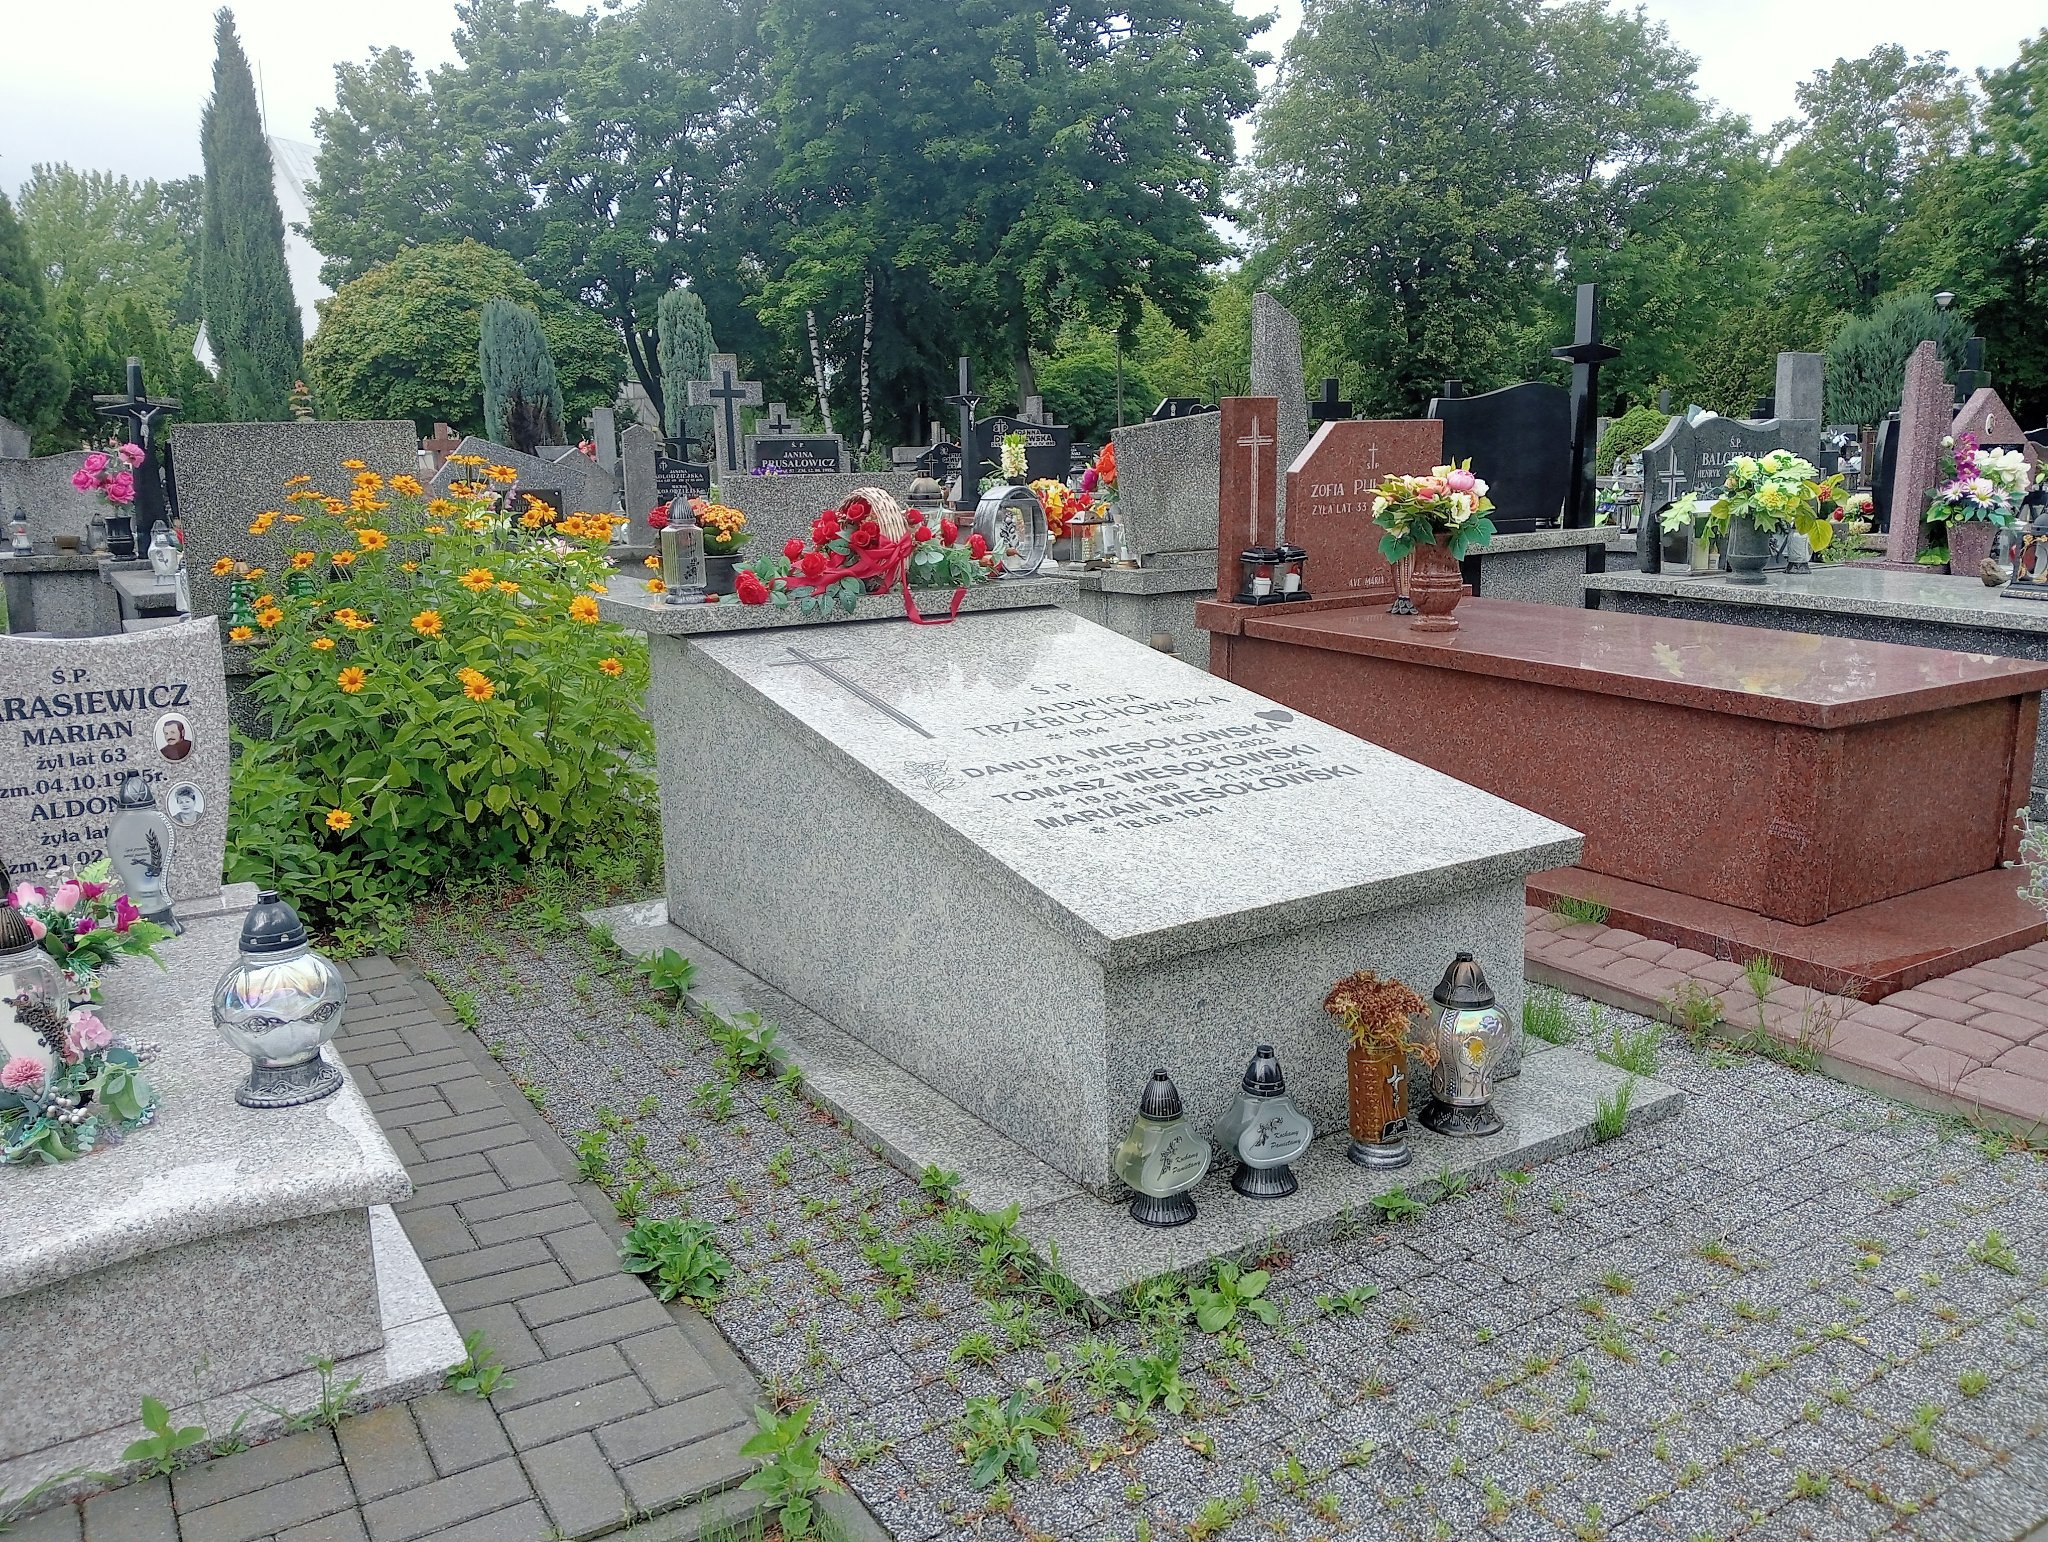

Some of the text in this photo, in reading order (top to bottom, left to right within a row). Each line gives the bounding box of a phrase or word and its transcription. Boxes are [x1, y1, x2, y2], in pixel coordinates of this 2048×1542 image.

[783, 451, 813, 459] JANINA
[1697, 469, 1721, 478] HENRYK
[1311, 483, 1345, 498] ZOFIA
[1336, 503, 1352, 514] LAT
[1356, 502, 1367, 512] 33
[1349, 574, 1385, 587] AVE MARIA
[963, 695, 1232, 737] TRZEBUCHOWSKA
[1024, 694, 1145, 715] JADWIGA
[21, 721, 133, 748] MARIAN
[36, 748, 127, 772] żył lat 63
[960, 721, 1292, 778] DANUTA WESOŁOWSKA
[0, 768, 168, 799] zm.04.10.195r.
[991, 743, 1322, 804] TOMASZ WESOŁOWSKI
[1033, 764, 1363, 830] MARIAN WESOŁOWSKI
[41, 826, 109, 848] żyła lat
